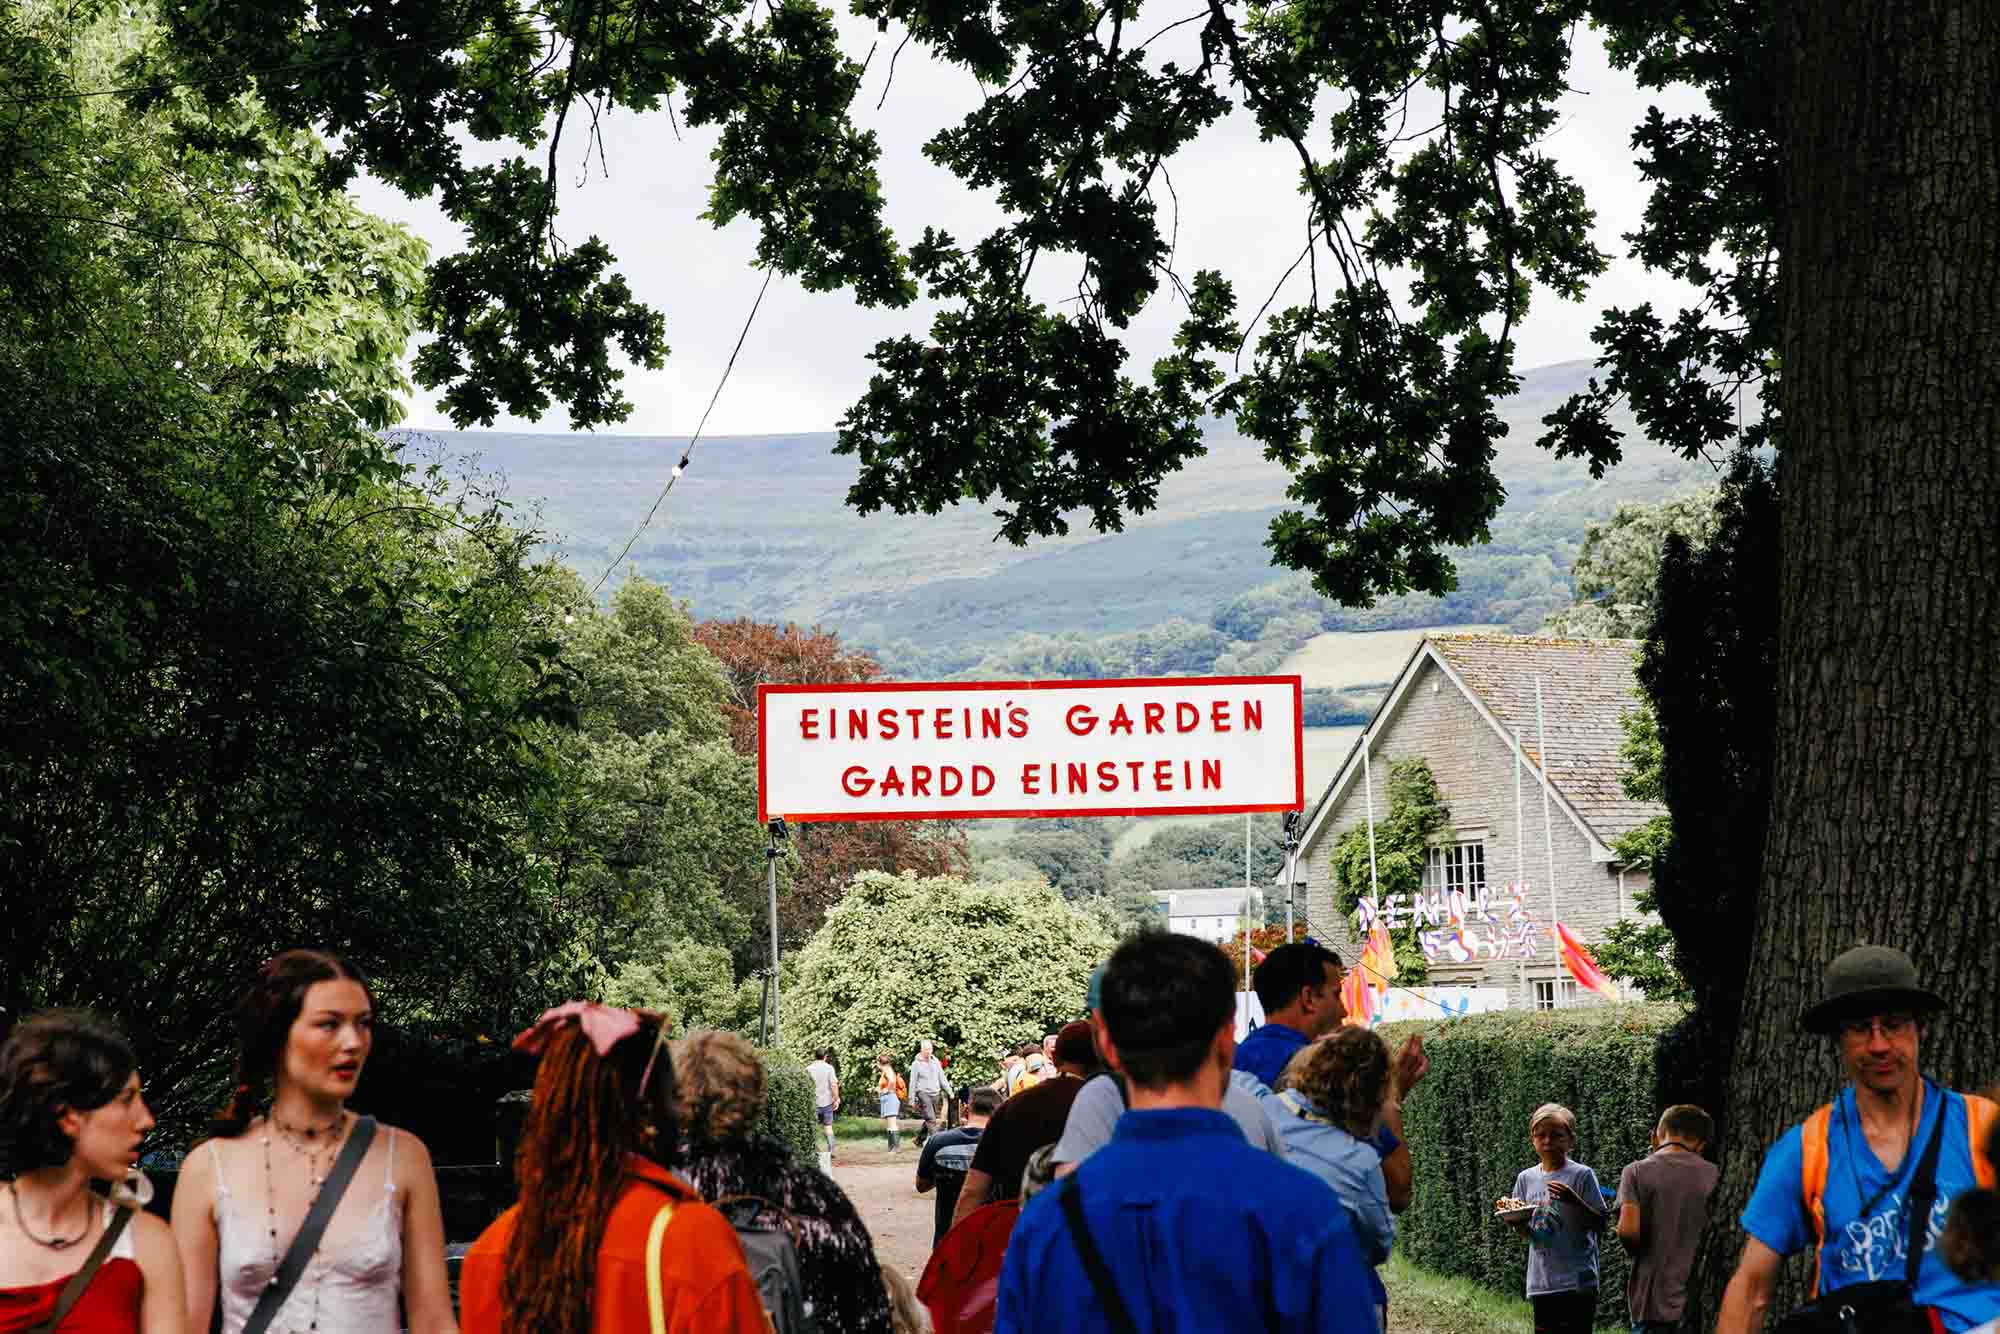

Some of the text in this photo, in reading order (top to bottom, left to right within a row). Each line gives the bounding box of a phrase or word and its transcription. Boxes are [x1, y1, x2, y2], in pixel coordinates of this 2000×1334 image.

[799, 699, 1263, 740] EINSTEIN'S GARDEN
[841, 759, 1222, 798] GARDD EINSTEIN
